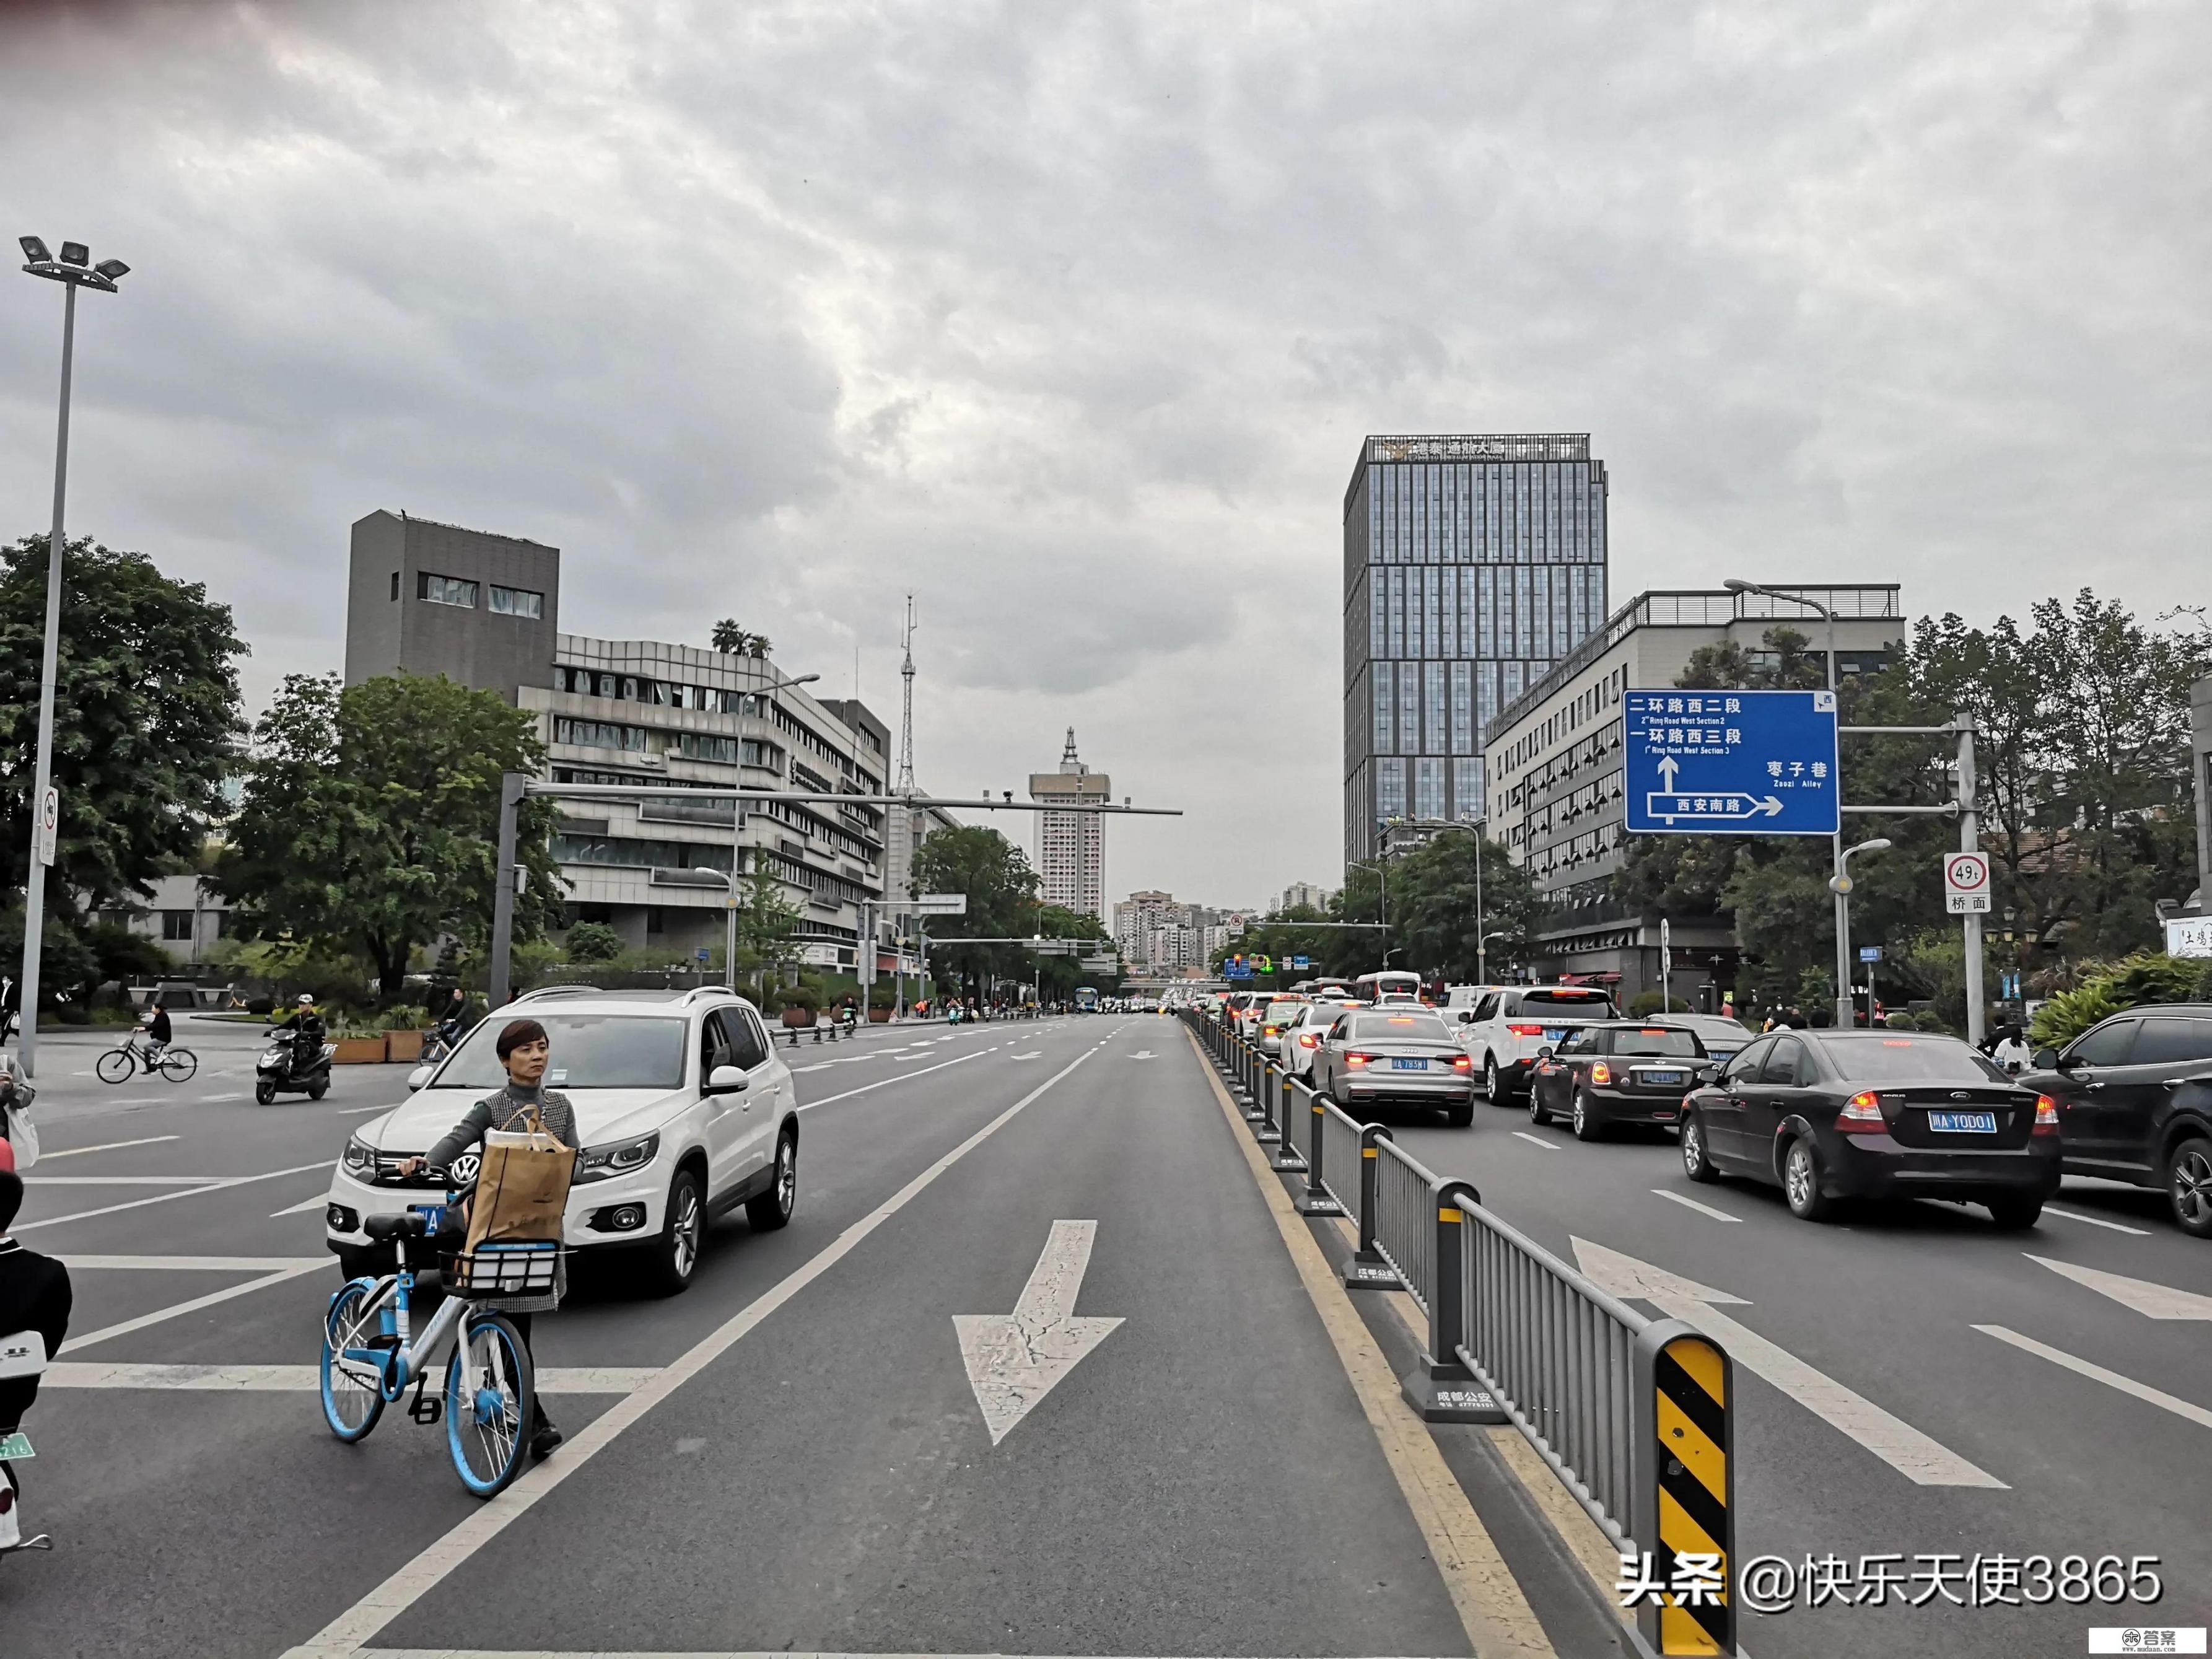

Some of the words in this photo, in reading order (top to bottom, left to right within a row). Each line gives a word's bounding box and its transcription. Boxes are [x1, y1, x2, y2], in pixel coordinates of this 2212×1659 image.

[1630, 698, 1741, 714] 二环路西二段
[1824, 695, 1832, 704] 西
[1650, 717, 1663, 725] Ring
[1696, 717, 1720, 725] Section
[1720, 717, 1725, 725] 2
[1630, 728, 1741, 744] 一环路西三段
[1652, 746, 1665, 755] Ring
[1700, 746, 1723, 755] Section
[1767, 761, 1827, 777] 枣子巷
[1773, 779, 1795, 787] Zaozi
[1802, 780, 1822, 788] Alley
[1677, 799, 1740, 812] 西安南路
[1956, 865, 1978, 880] 49t
[1952, 896, 1985, 910] 桥面
[1437, 1391, 1492, 1403] 成都公安
